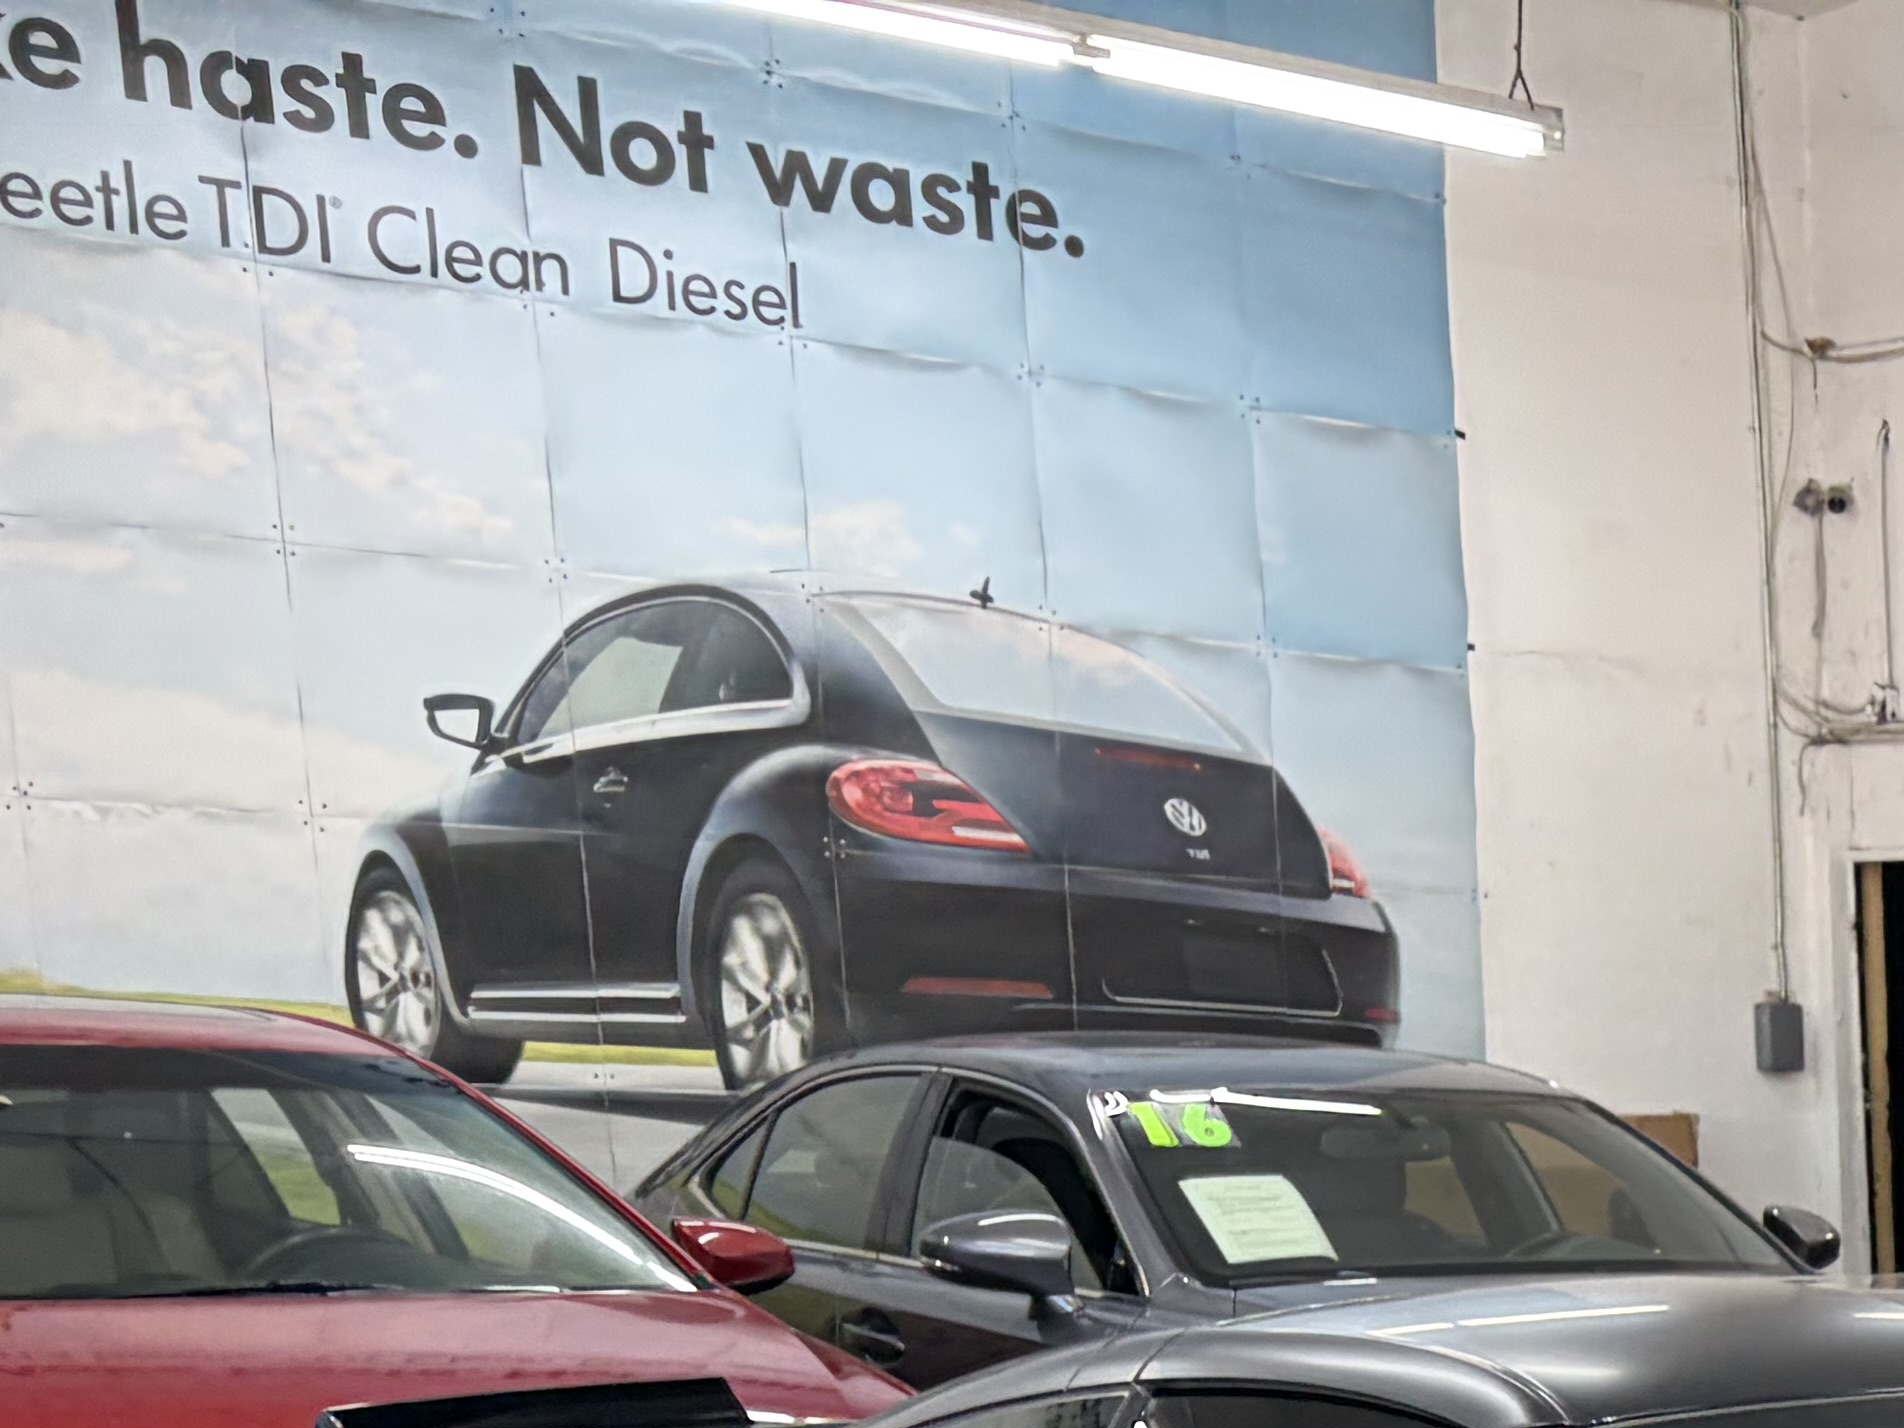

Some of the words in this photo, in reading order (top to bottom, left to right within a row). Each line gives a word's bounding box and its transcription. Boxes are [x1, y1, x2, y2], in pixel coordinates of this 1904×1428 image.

[0, 12, 82, 90] e
[115, 0, 478, 158] haste.
[513, 64, 716, 193] Not
[746, 141, 1085, 258] waste.
[367, 205, 570, 296] Clean
[608, 237, 803, 329] Diesel
[1127, 1101, 1233, 1148] 16
